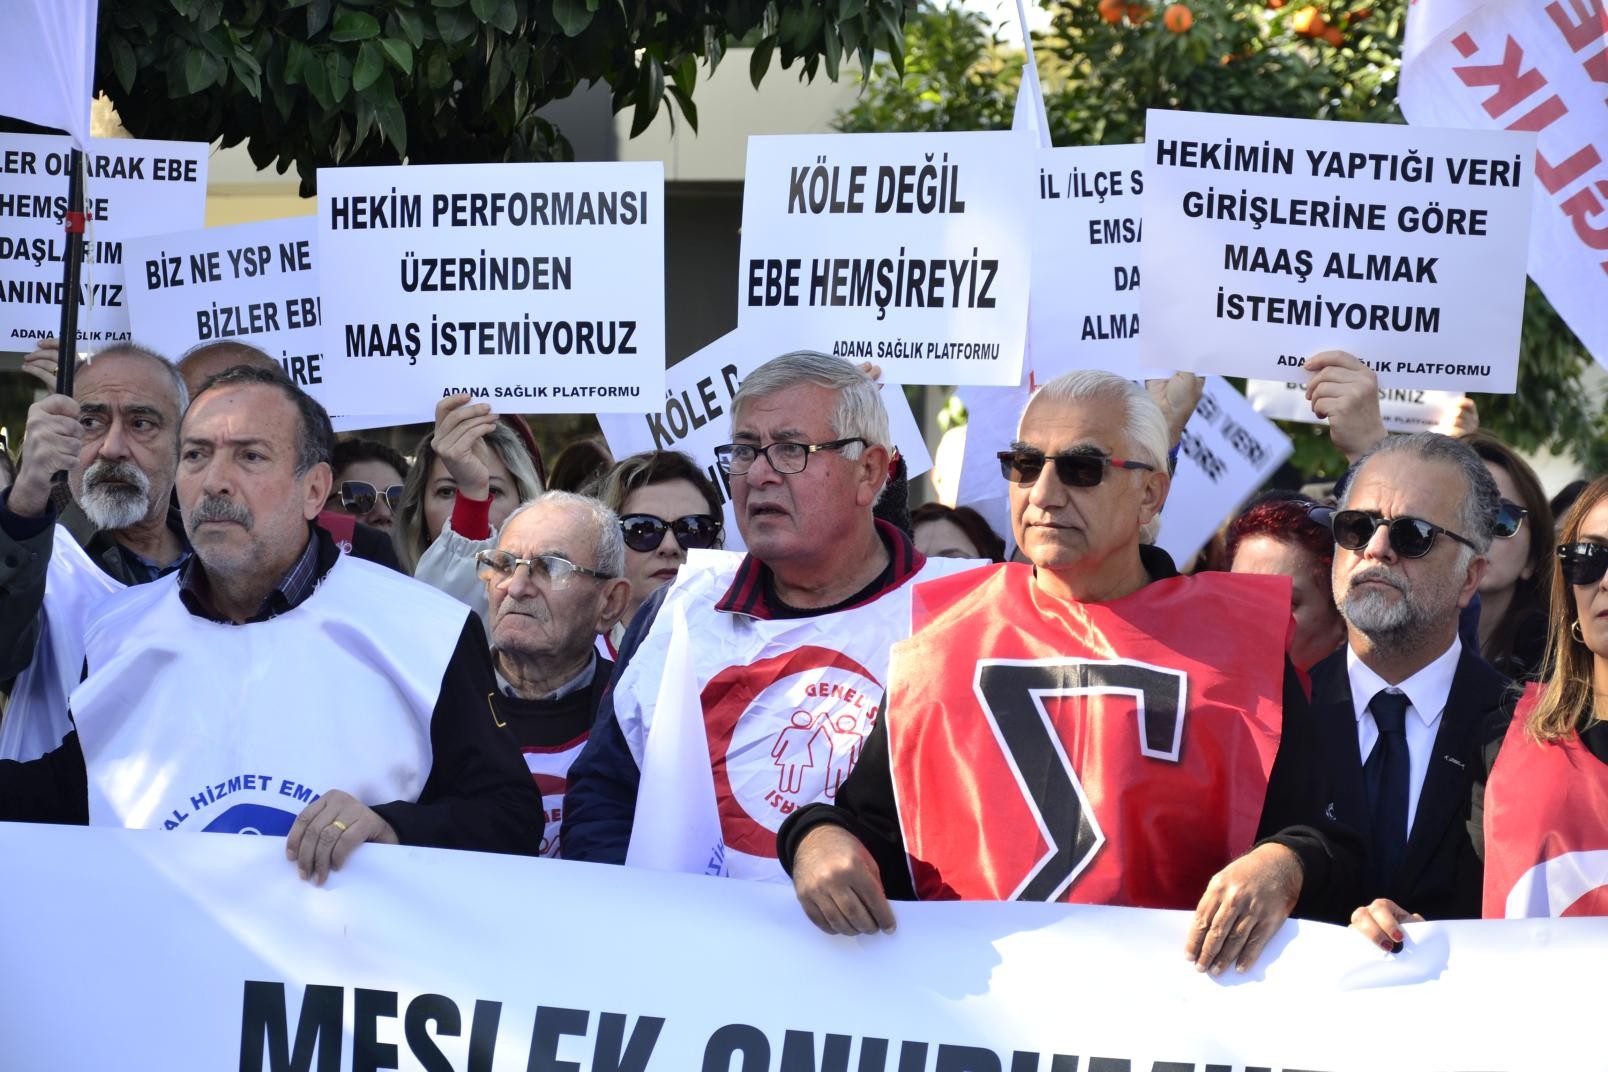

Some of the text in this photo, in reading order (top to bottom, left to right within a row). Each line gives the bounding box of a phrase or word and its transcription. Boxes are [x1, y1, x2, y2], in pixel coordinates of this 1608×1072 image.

[0, 151, 36, 174] ER
[152, 158, 198, 182] EBE
[1156, 137, 1521, 188] HEKİMİN YAPTIĞI VERİ
[787, 152, 966, 215] KÖLE DEĞİL
[1040, 168, 1061, 200] İL
[0, 194, 109, 225] HEMŞE
[331, 186, 647, 230] HEKİM PERFORMANSI
[1182, 186, 1488, 236] GİRİŞLERİNE GÖRE
[0, 237, 122, 267] DAŞLRIM
[145, 240, 312, 290] BİZ NE YSP NE
[400, 248, 572, 293] ÜZERİNDEN
[1224, 244, 1439, 284] MAAŞ ALMAK
[747, 246, 999, 321] EBE HEMŞİREYİZ
[196, 297, 321, 344] BİZLER EB
[1216, 286, 1441, 333] İSTEMİYORUM
[10, 328, 55, 340] ADANA
[345, 312, 637, 366] MAAŞ İSTEMİYORUZ
[833, 338, 1000, 360] ADANA SAĞLIK PLATFORMU
[283, 350, 323, 385] İRE
[1396, 362, 1491, 377] PLATFORMU
[443, 384, 640, 398] ADANA SAĞLIK PLATFORMU
[645, 376, 723, 450] KÖLE
[804, 682, 865, 709] GENEL
[190, 774, 272, 811] HİZMET
